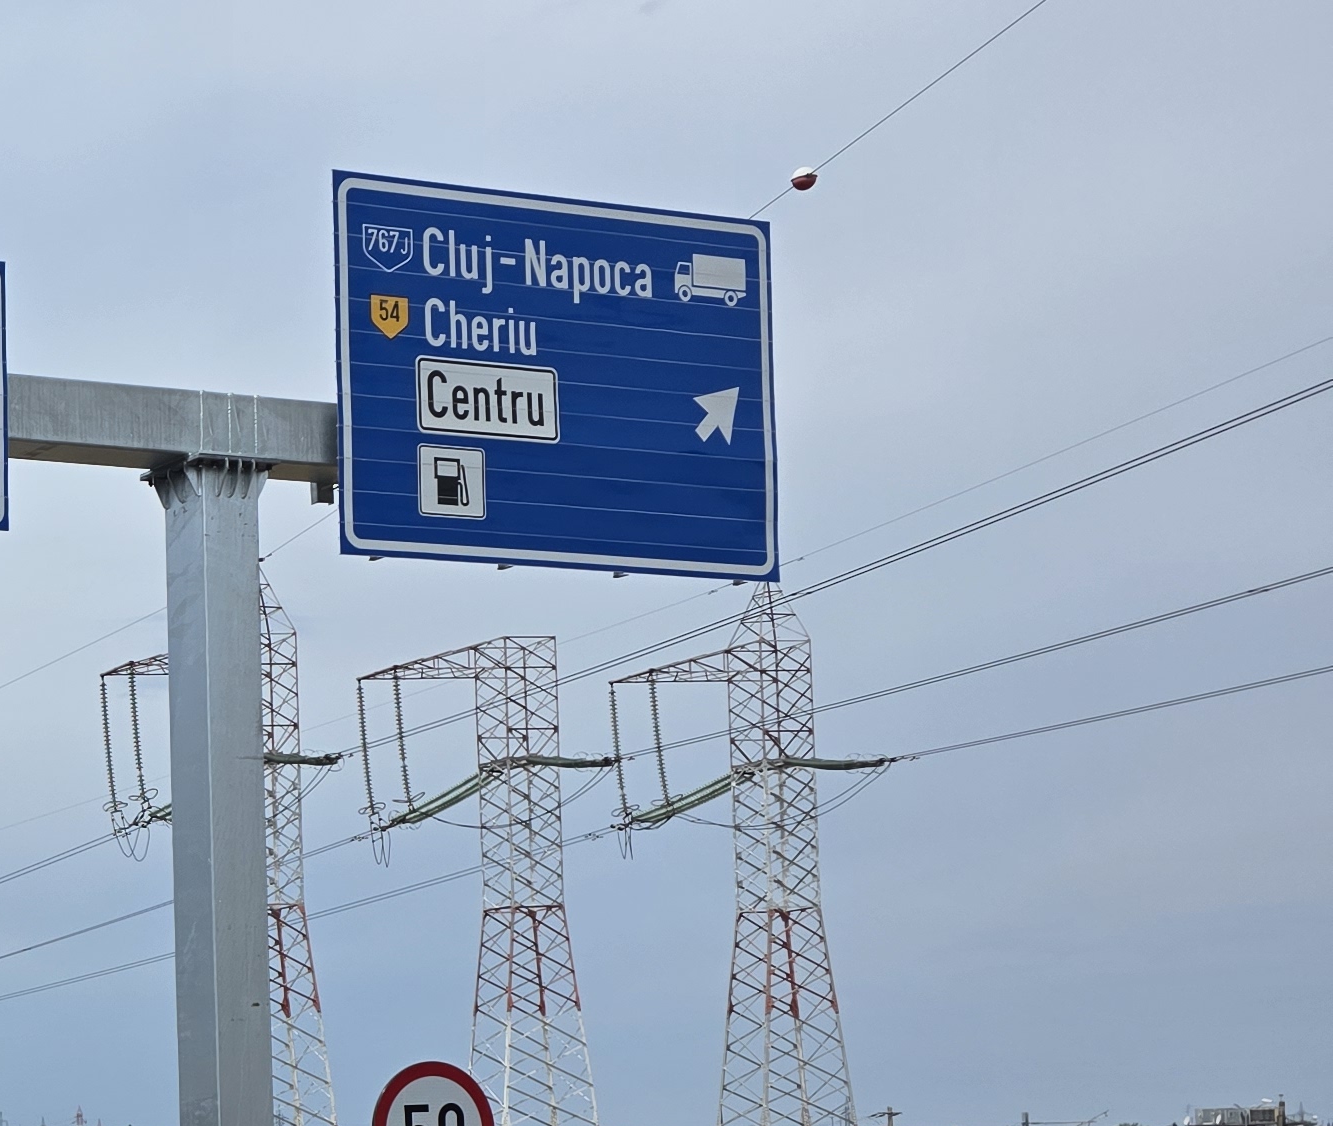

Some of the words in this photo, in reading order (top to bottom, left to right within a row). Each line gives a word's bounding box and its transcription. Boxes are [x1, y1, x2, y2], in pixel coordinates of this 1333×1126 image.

[367, 228, 408, 255] 767J
[422, 227, 653, 303] Cluj-Napoca
[379, 299, 400, 322] 54
[424, 297, 537, 355] Cheriu
[426, 369, 545, 427] Centru
